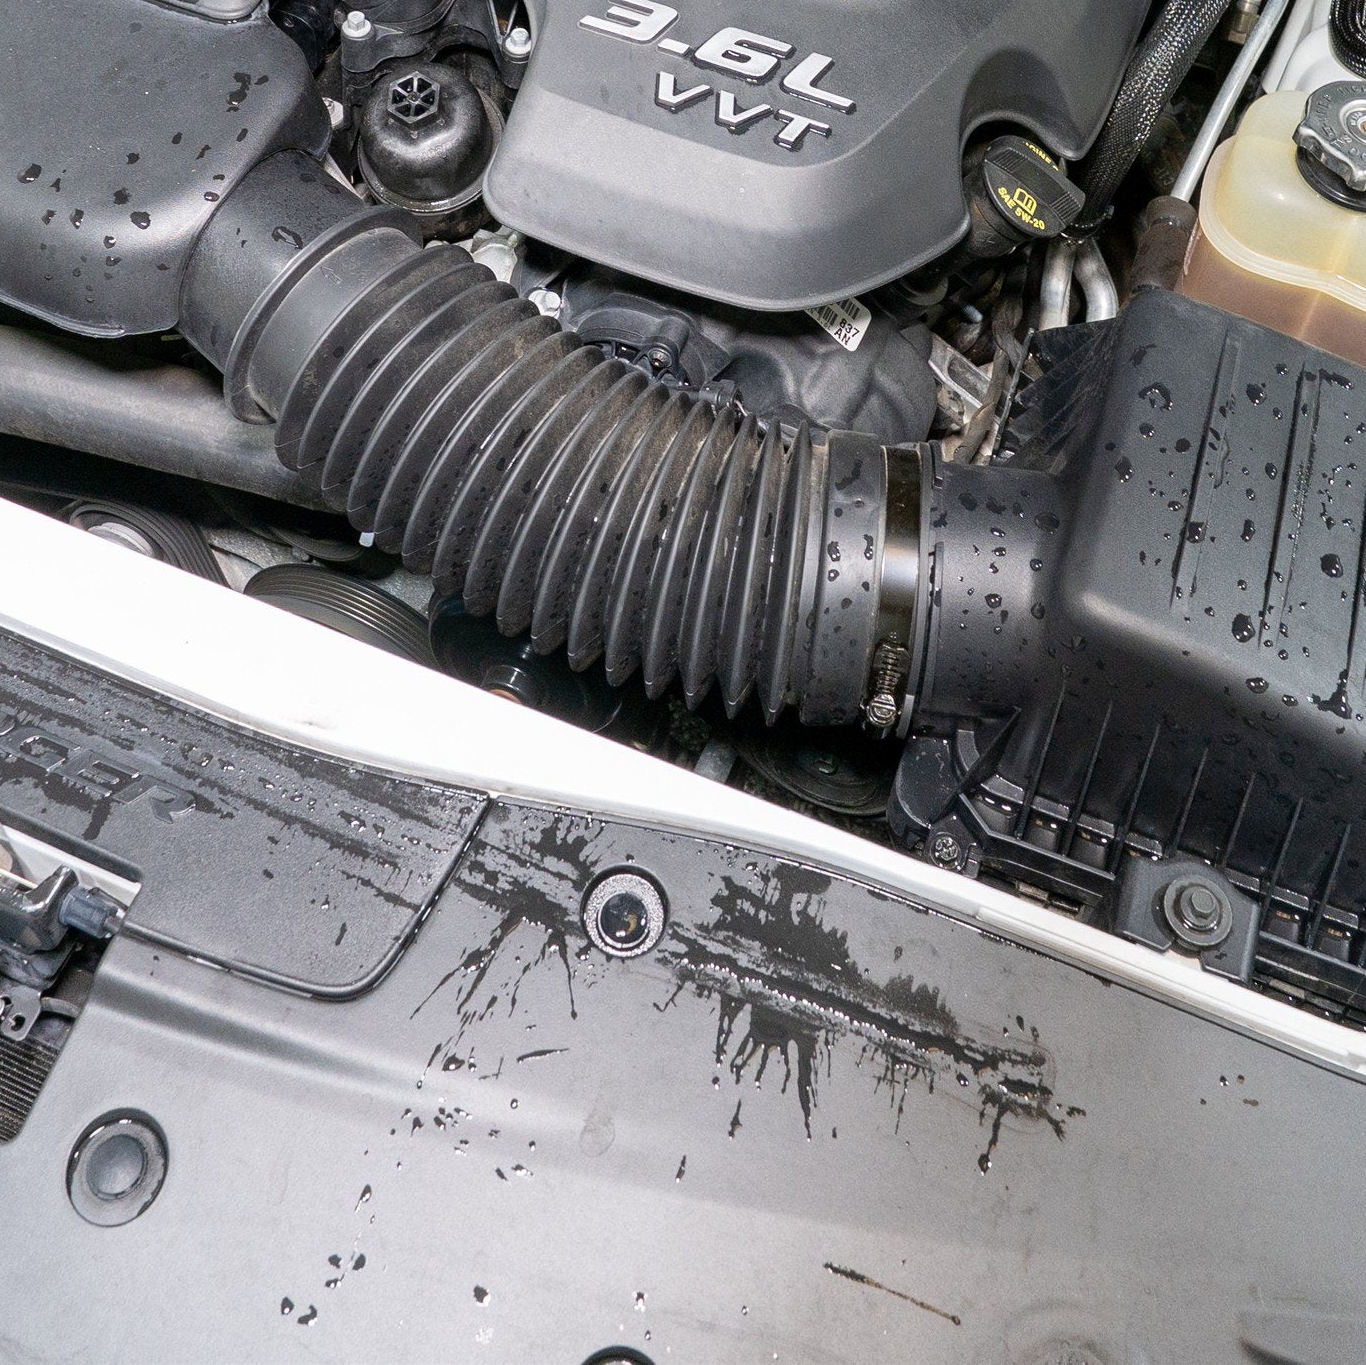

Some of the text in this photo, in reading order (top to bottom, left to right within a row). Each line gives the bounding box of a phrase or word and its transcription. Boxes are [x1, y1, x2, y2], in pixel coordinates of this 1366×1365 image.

[655, 71, 832, 150] VVT
[998, 187, 1046, 230] SAE 5W-20
[834, 328, 850, 345] AN
[839, 318, 860, 337] 837
